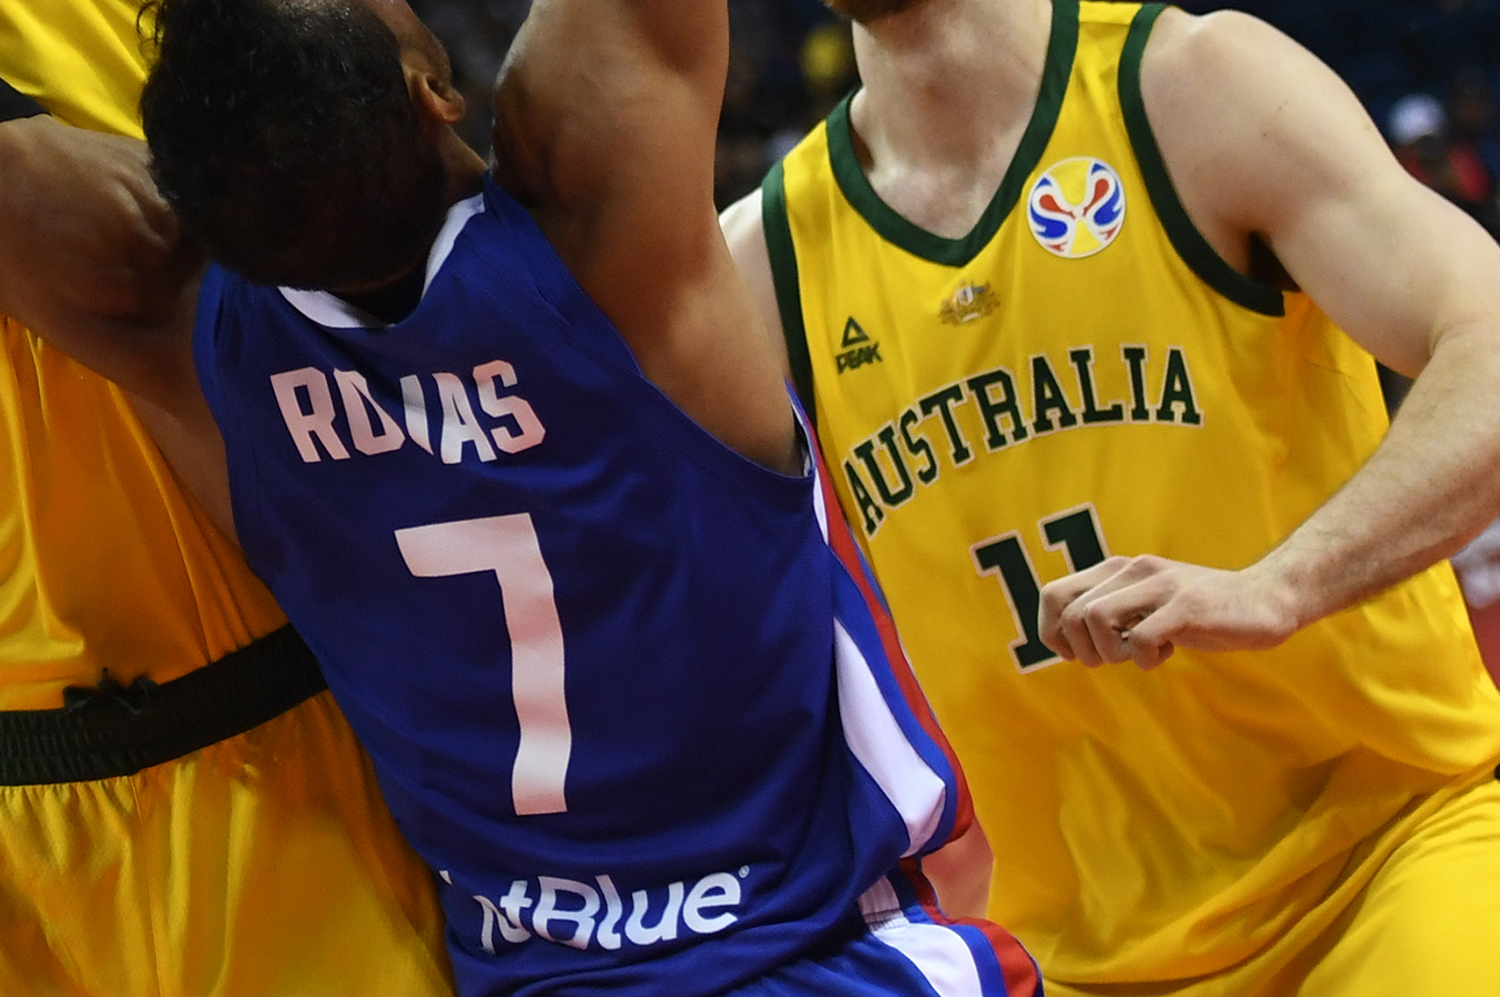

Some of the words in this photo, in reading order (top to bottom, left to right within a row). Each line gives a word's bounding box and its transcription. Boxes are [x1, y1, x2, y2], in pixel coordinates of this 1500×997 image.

[835, 342, 883, 375] PEAK
[842, 343, 1204, 539] AUSTRALIA
[394, 512, 572, 816] 7
